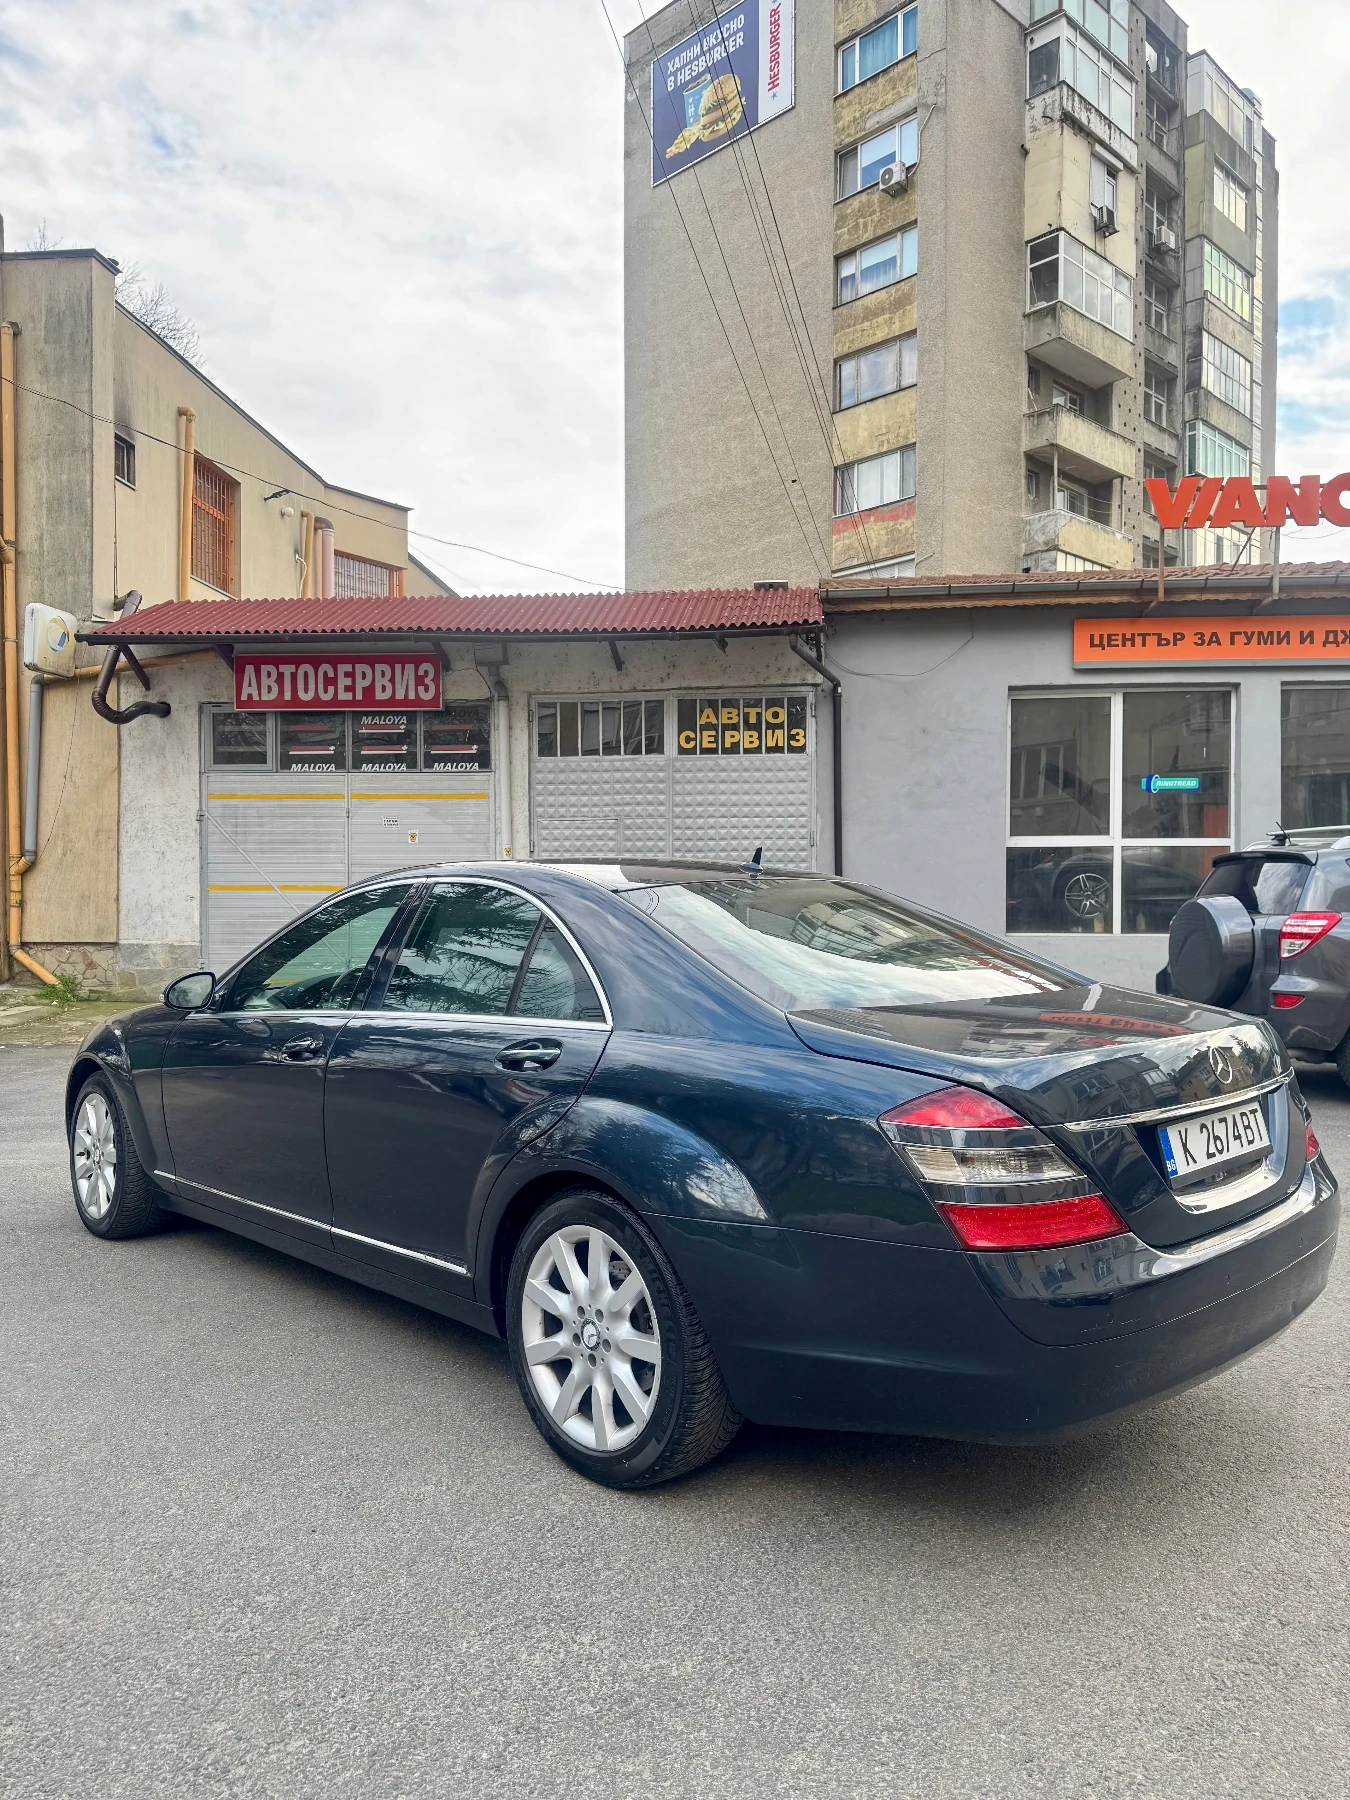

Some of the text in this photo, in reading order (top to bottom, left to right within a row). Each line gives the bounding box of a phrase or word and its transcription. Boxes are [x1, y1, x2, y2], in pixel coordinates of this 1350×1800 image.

[667, 14, 745, 74] ХАПНИ ВКУСНО
[768, 3, 781, 92] HESBURGER
[677, 31, 744, 86] HESBURGER
[1089, 632, 1186, 650] ЦЕНТЪР
[1193, 631, 1222, 647] ЗА
[1229, 630, 1291, 646] ГУМИ
[1299, 630, 1315, 645] И
[240, 662, 436, 702] АВТОСЕРВИЗ
[361, 715, 407, 725] MALOYA
[699, 706, 785, 725] АВТО
[679, 729, 806, 749] СЕРВИЗ
[291, 763, 336, 772] MALOYA
[361, 763, 407, 772] MALOYA
[433, 762, 479, 771] MALOYA
[1166, 1160, 1177, 1172] BG
